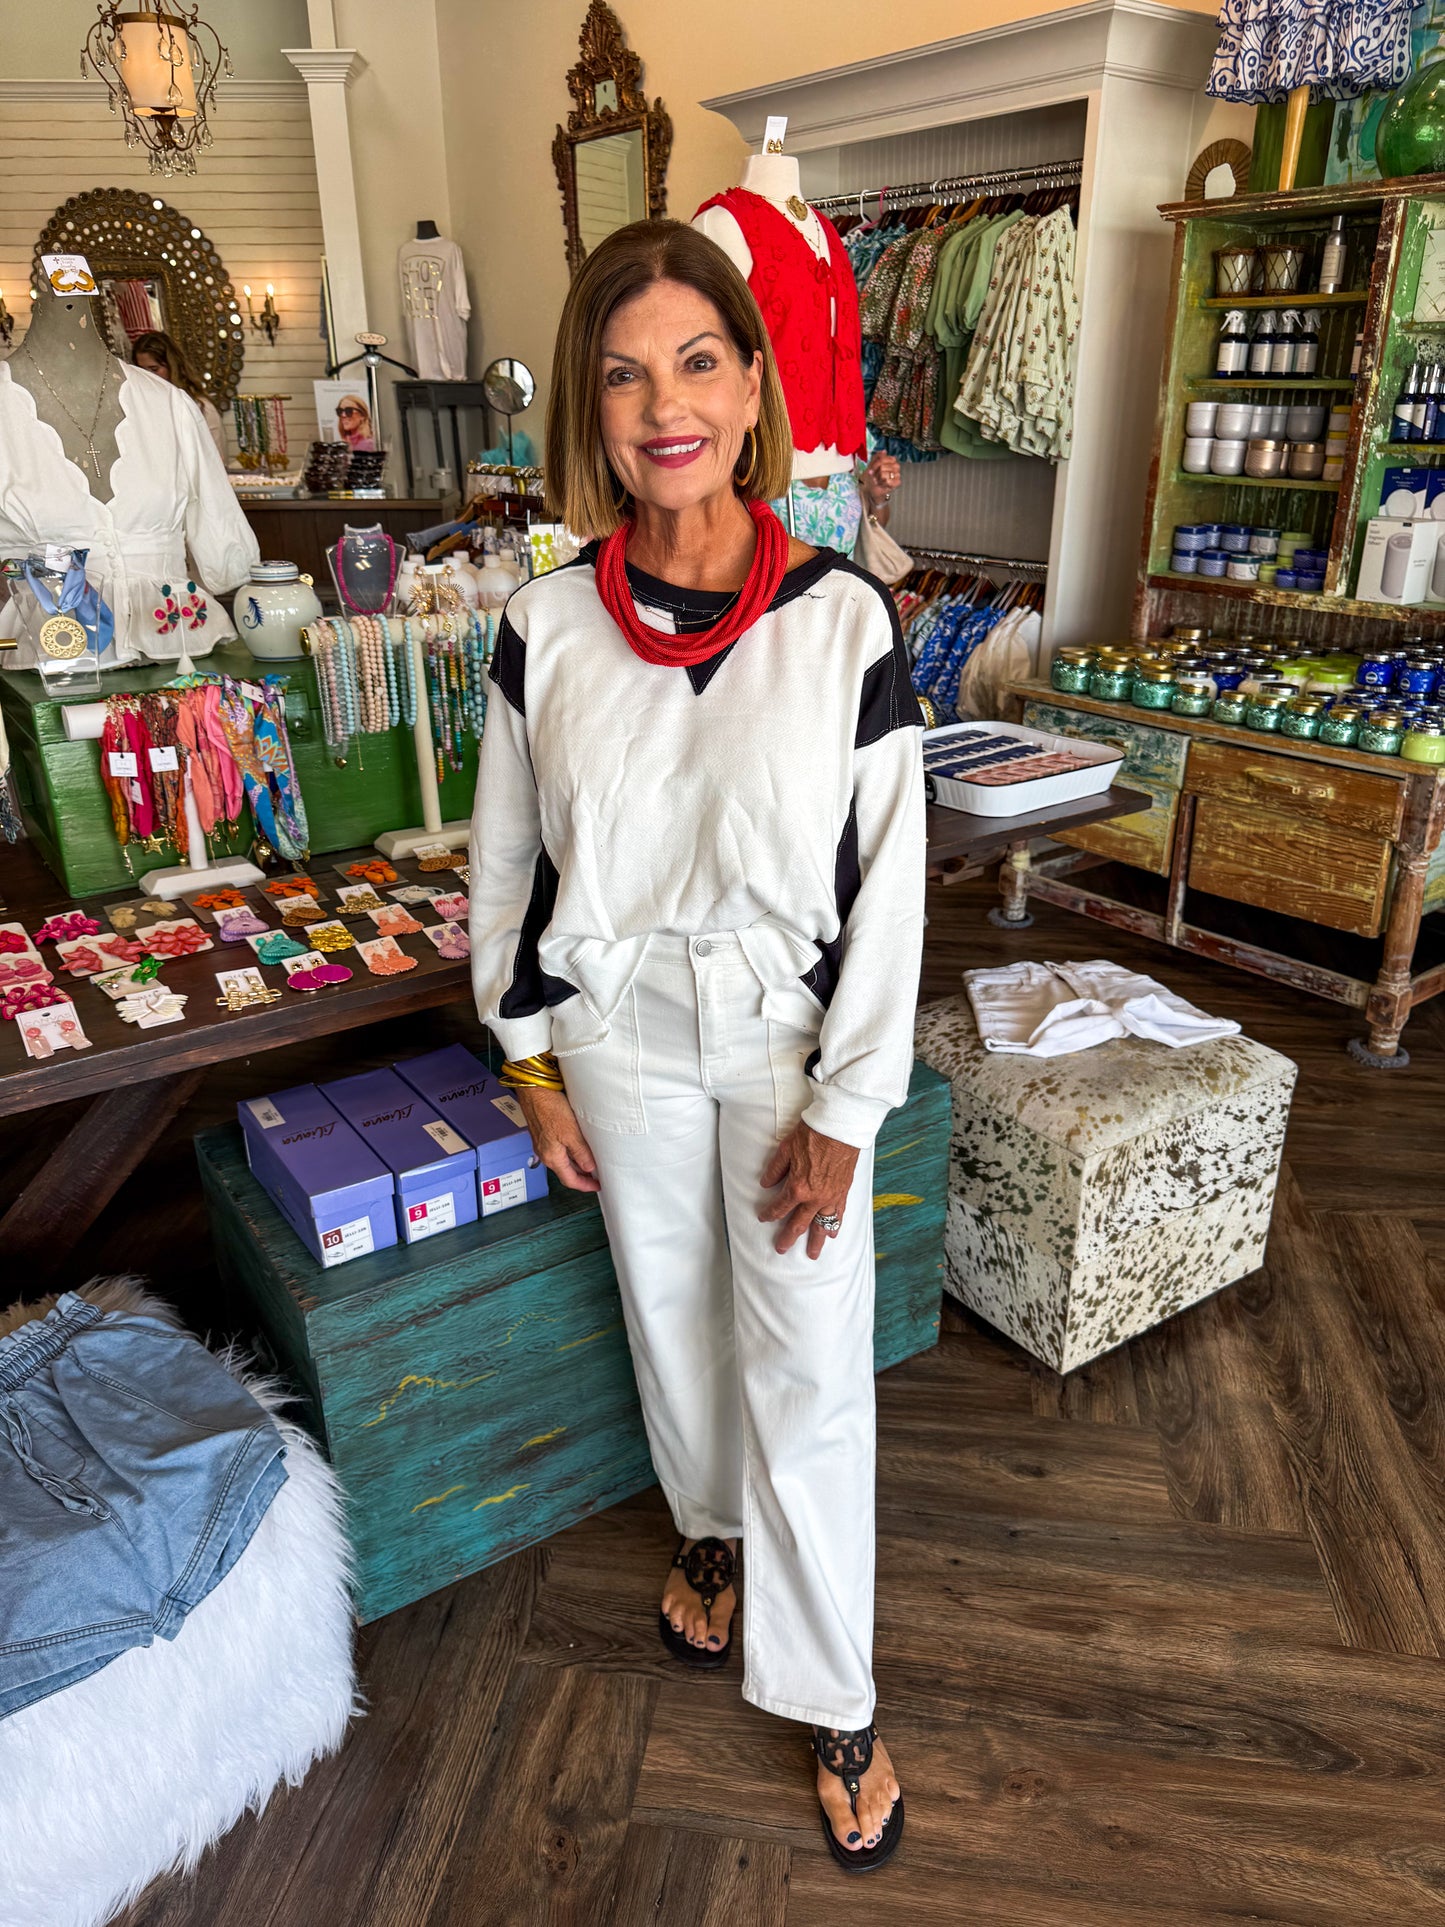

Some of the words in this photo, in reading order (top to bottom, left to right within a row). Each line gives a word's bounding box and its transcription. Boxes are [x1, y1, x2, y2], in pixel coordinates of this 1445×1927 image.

[488, 1184, 496, 1194] 9
[414, 1209, 423, 1219] 9
[326, 1234, 340, 1247] 10
